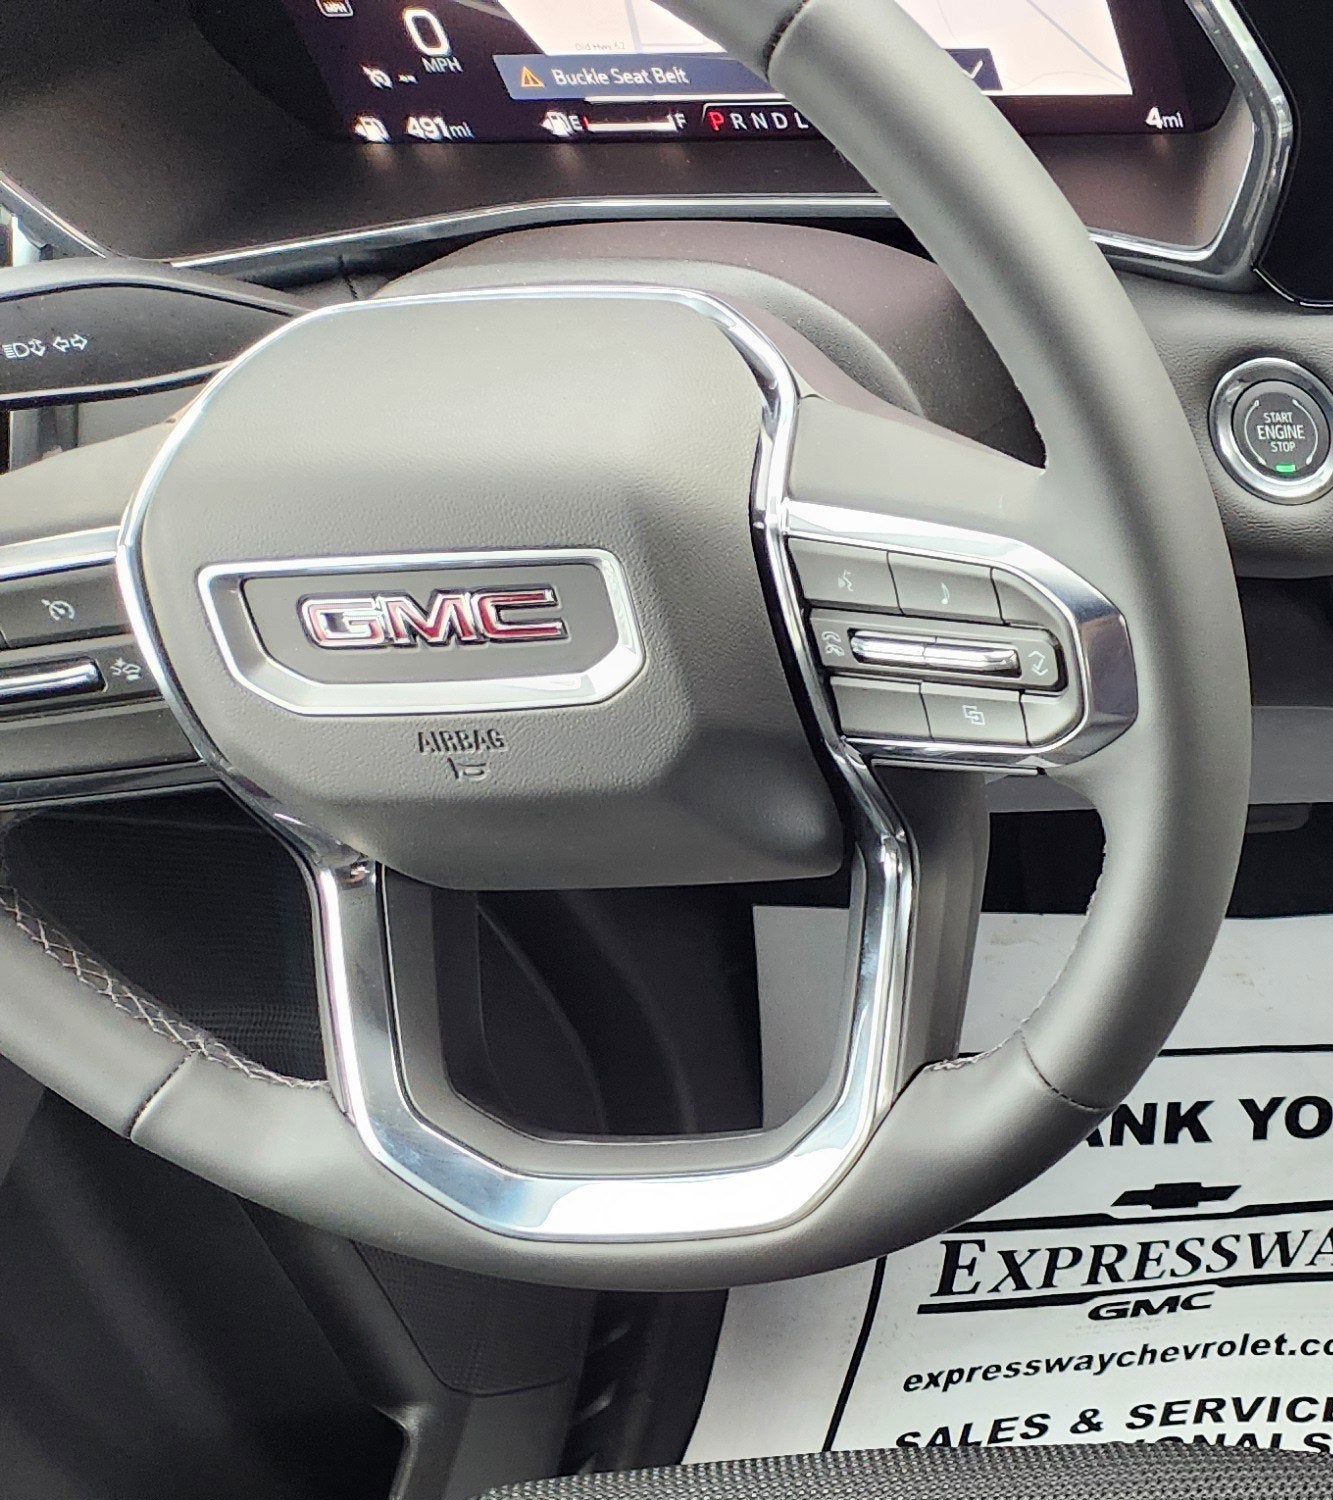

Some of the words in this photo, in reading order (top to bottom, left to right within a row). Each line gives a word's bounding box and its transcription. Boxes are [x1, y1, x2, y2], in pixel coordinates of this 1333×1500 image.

[403, 7, 451, 56] 0
[421, 57, 463, 73] MPH
[551, 68, 609, 86] Buckle
[610, 67, 653, 84] Seat
[651, 66, 690, 84] Belt
[571, 117, 582, 130] E
[707, 111, 725, 131] P
[730, 113, 747, 130] R
[750, 112, 771, 130] N
[773, 112, 788, 128] D
[796, 111, 810, 128] L
[1263, 412, 1293, 424] START
[1256, 424, 1306, 440] ENGINE
[1270, 441, 1295, 453] STOP
[300, 585, 569, 649] GMC
[416, 728, 504, 755] AIRBAG
[1087, 1291, 1216, 1322] GMC
[894, 1413, 1051, 1449] SALES
[1069, 1408, 1104, 1435] &
